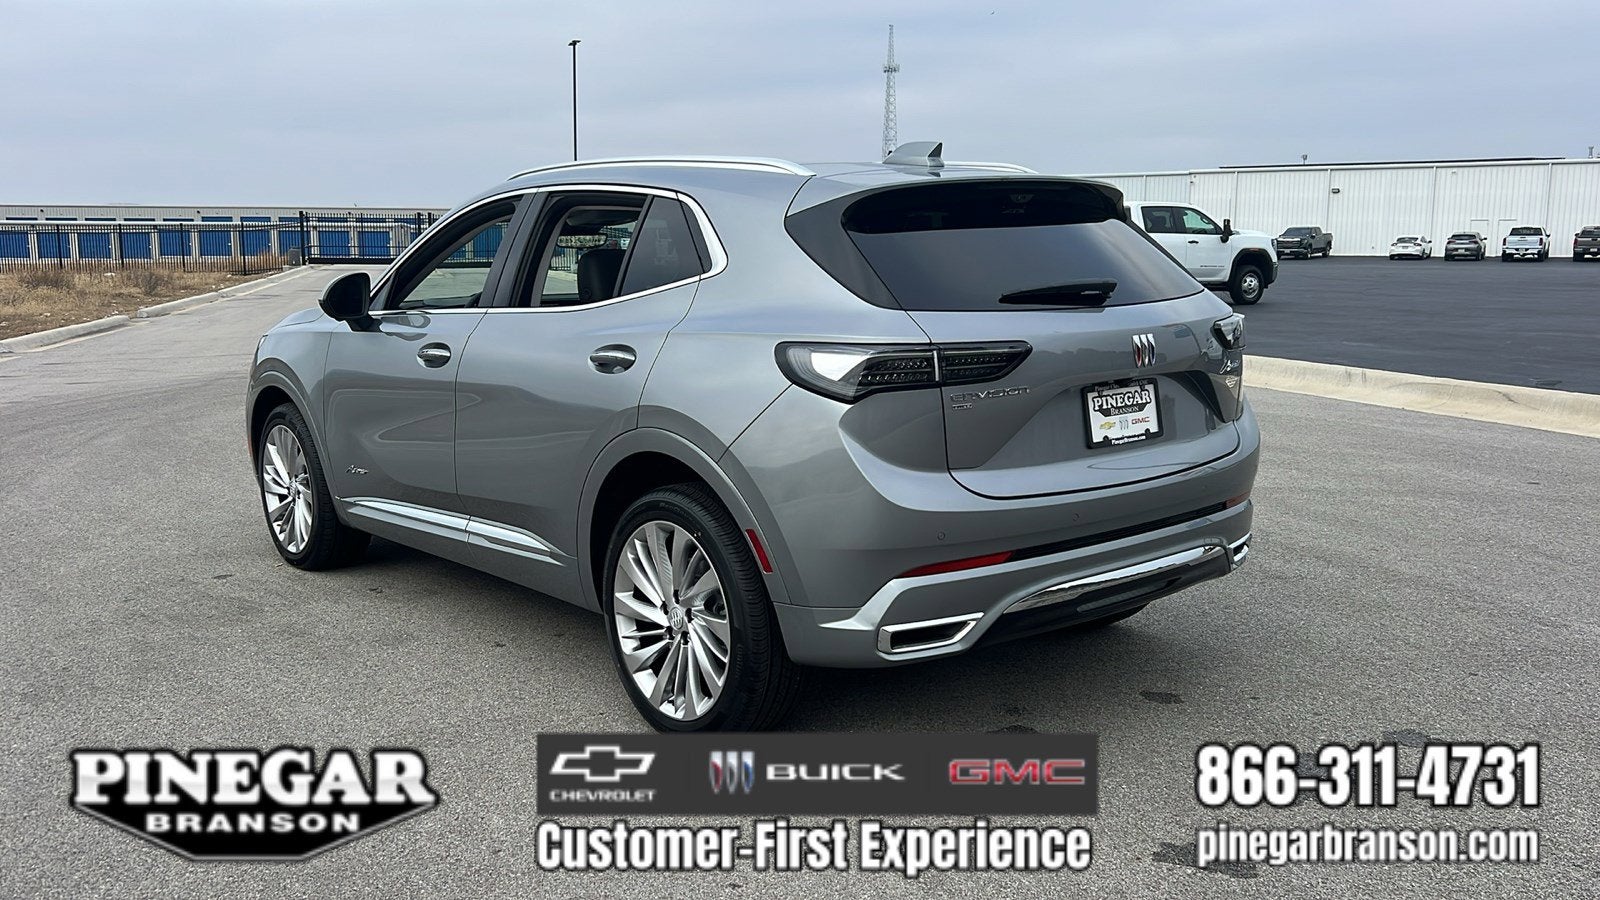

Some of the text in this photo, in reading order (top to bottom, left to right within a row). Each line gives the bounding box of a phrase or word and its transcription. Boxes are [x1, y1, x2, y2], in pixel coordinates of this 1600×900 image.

[1093, 391, 1151, 410] PINEGAR
[1110, 405, 1139, 416] BRANSON
[1131, 416, 1150, 425] GMC
